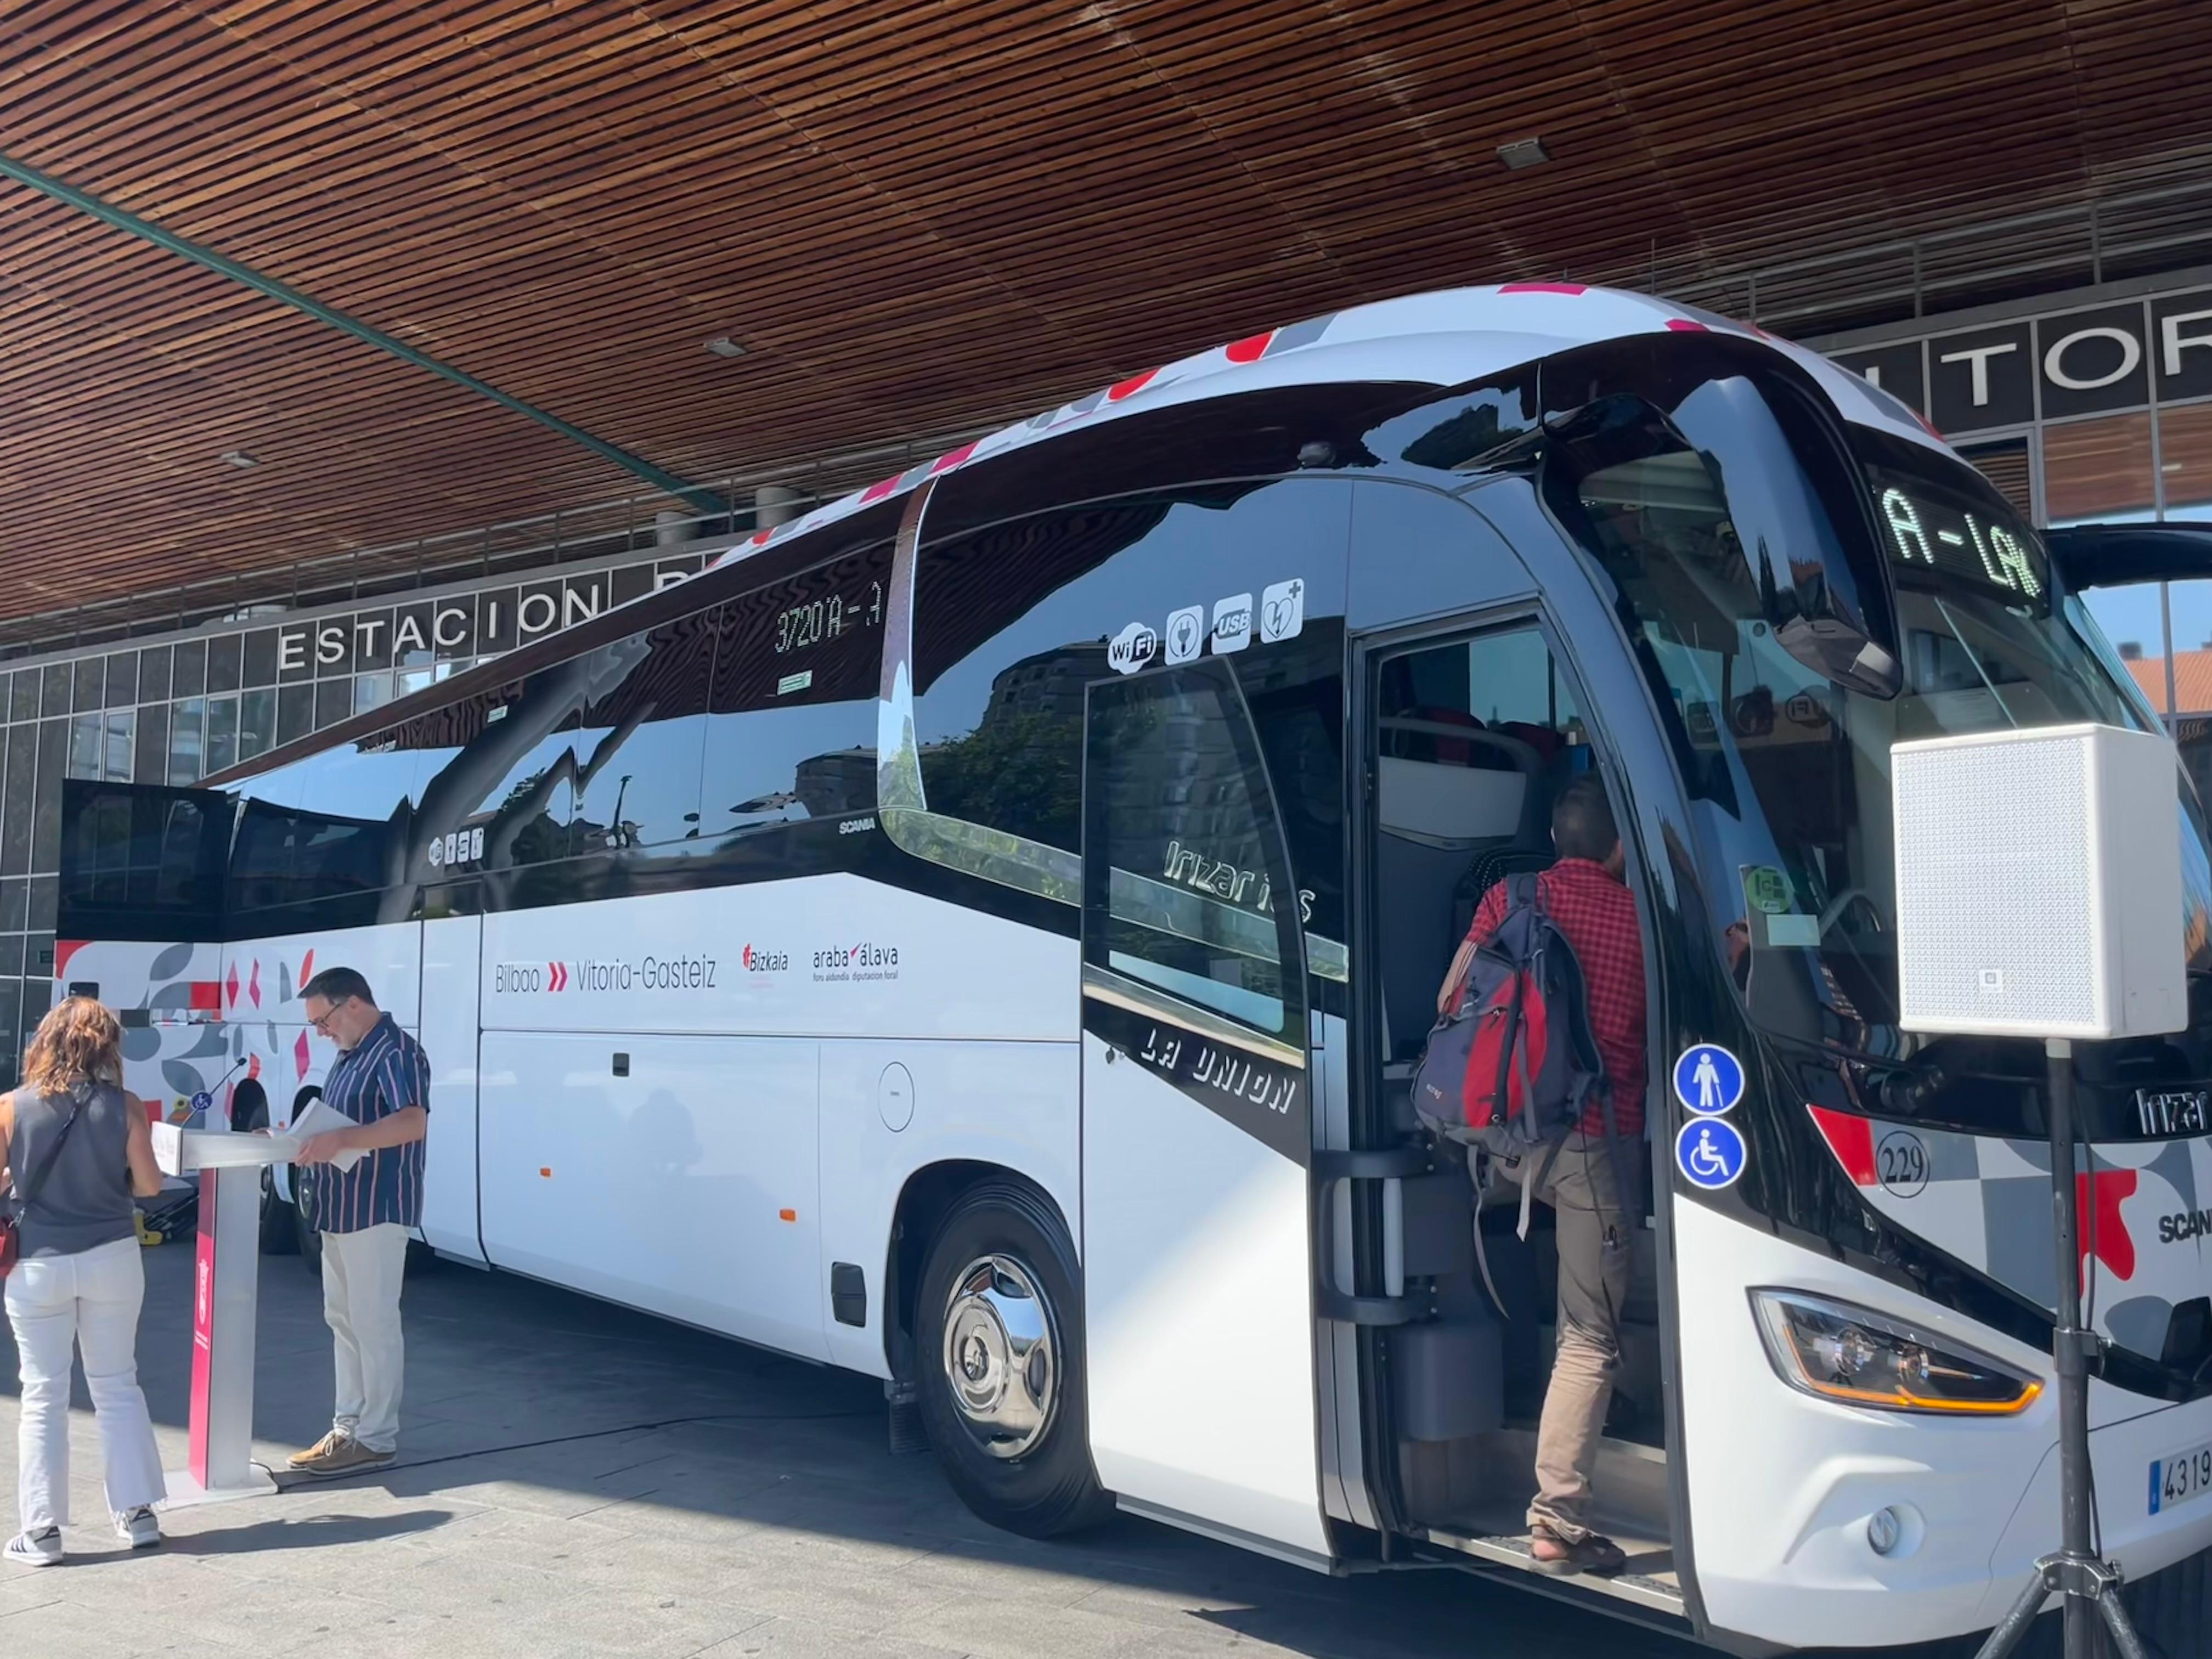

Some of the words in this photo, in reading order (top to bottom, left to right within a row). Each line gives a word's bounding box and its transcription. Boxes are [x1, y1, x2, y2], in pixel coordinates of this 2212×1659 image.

[280, 584, 599, 670] ESTACION
[1217, 611, 1252, 636] USB
[1112, 636, 1152, 661] WiFi
[839, 817, 876, 834] SCANIA
[1164, 840, 1255, 902] Irizar
[1257, 873, 1316, 923] is
[749, 951, 788, 972] Bizkaia
[813, 945, 849, 968] araba
[860, 943, 899, 967] álava
[496, 964, 540, 993] Bilbao
[576, 953, 716, 991] Vitoria-Gasteiz
[1882, 1145, 1924, 1183] 229
[2164, 1450, 2211, 1500] 4319
